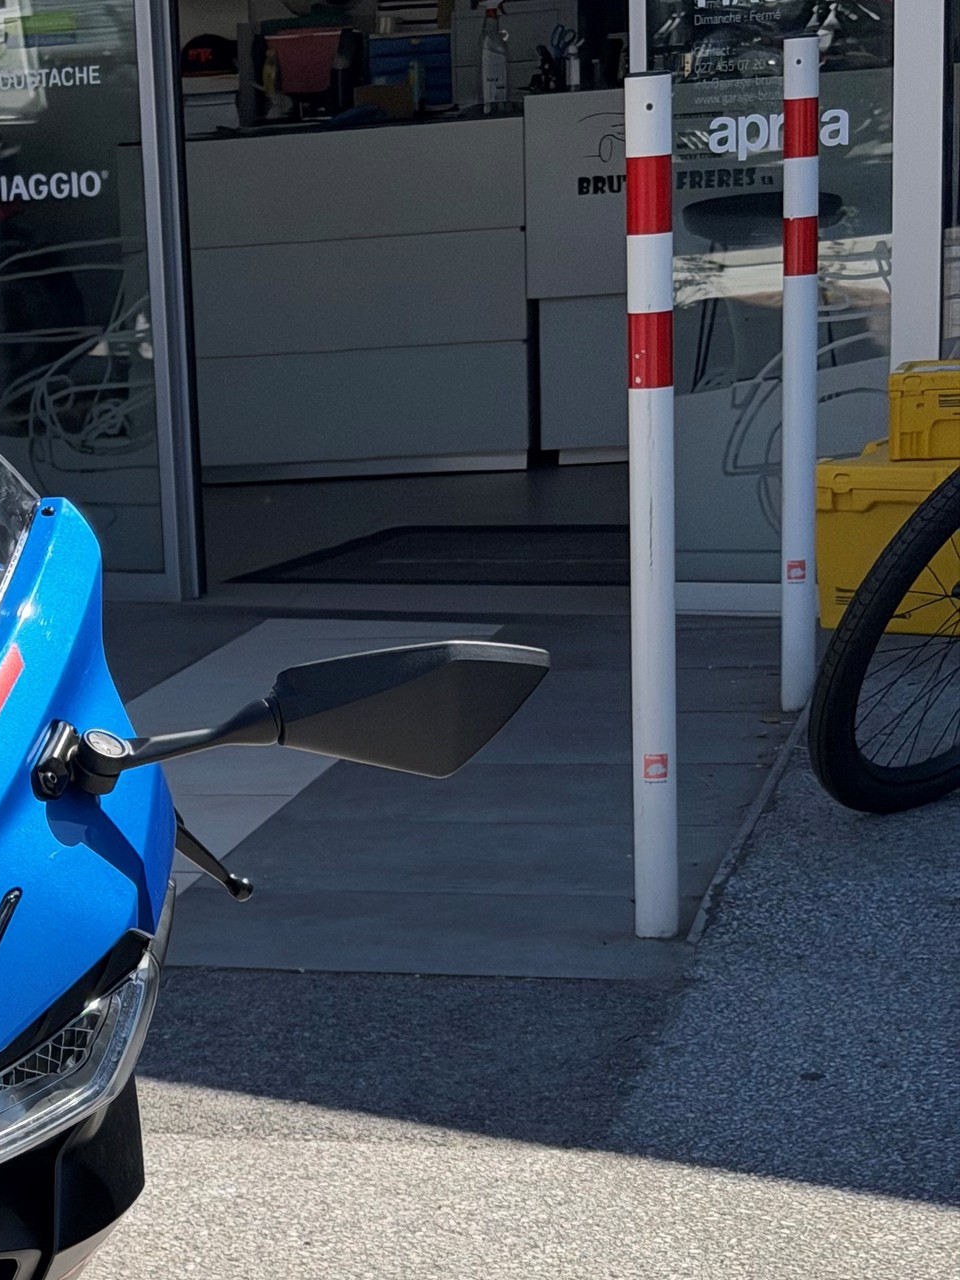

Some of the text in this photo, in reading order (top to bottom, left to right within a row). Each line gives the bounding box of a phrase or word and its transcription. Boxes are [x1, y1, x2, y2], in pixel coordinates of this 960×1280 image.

[694, 12, 741, 26] Dimanche
[750, 8, 781, 21] Fermé
[694, 62, 713, 74] 027
[708, 108, 849, 161] apra
[676, 167, 756, 190] FRERES
